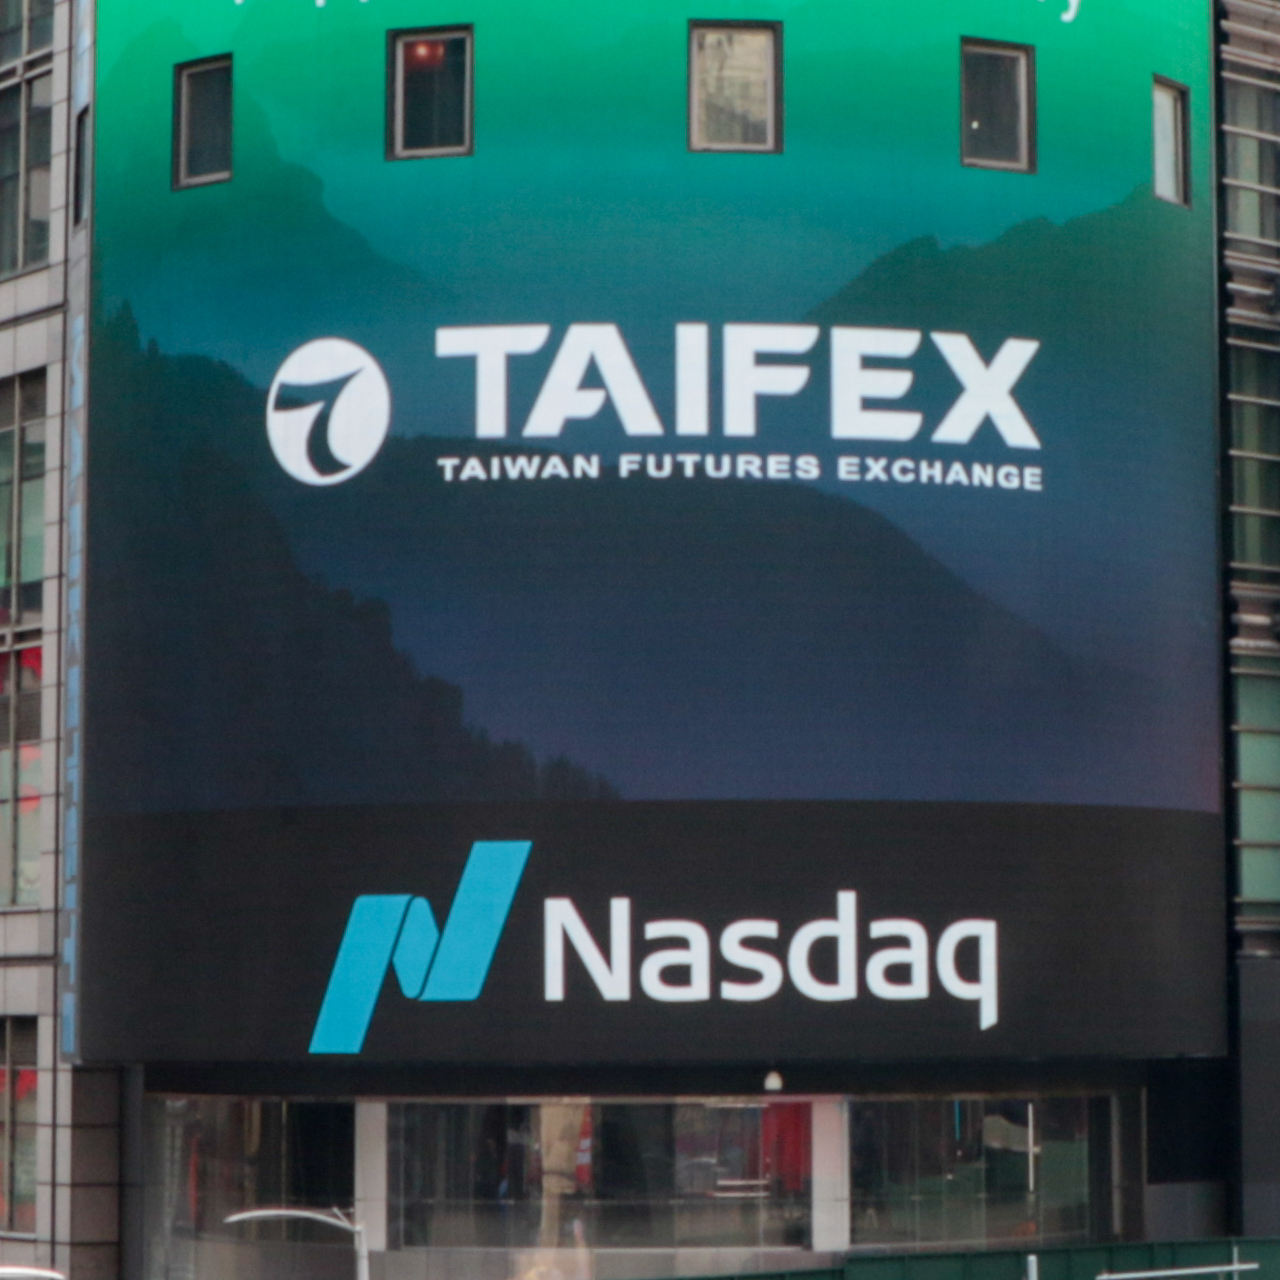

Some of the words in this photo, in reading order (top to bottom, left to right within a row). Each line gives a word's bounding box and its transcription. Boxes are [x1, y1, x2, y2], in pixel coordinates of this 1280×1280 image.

[435, 322, 1041, 450] TAIFEX
[437, 455, 601, 482] TAIWAN
[619, 453, 821, 481] FUTURES
[837, 456, 1043, 491] EXCHANGE
[544, 889, 998, 1030] Nasdaq
